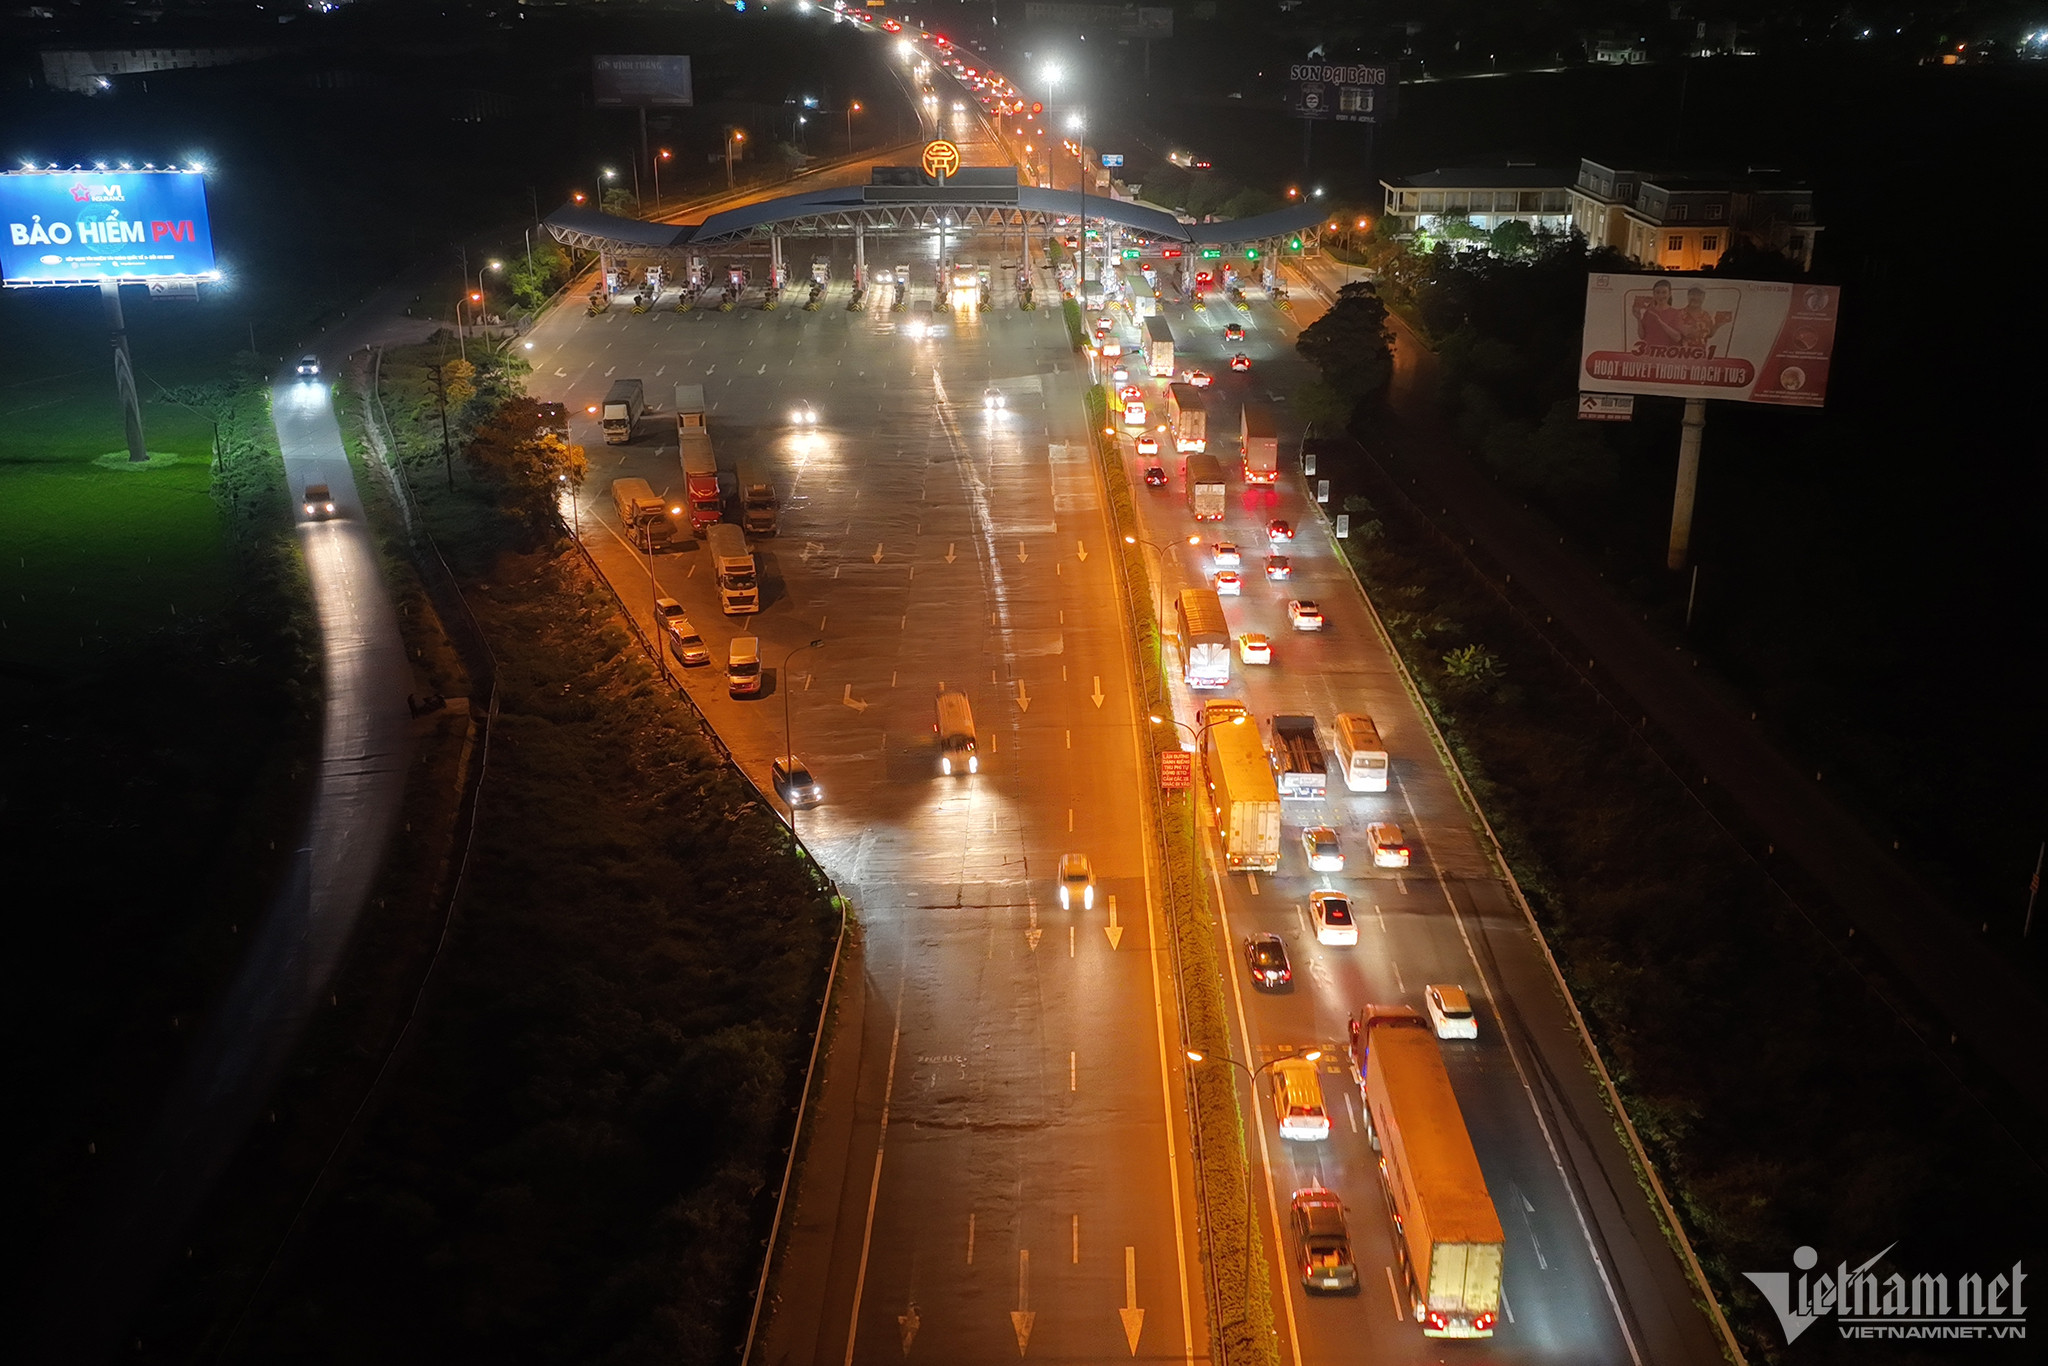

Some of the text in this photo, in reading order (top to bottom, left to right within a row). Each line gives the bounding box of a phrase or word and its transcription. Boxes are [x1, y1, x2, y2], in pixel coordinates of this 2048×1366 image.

[10, 209, 196, 245] BẢO HIỂM PVI
[1631, 341, 1718, 360] 3 TRONG 1
[1593, 359, 1619, 379] HOẠT
[1690, 365, 1721, 385] MẠCH
[1724, 367, 1746, 384] TW3
